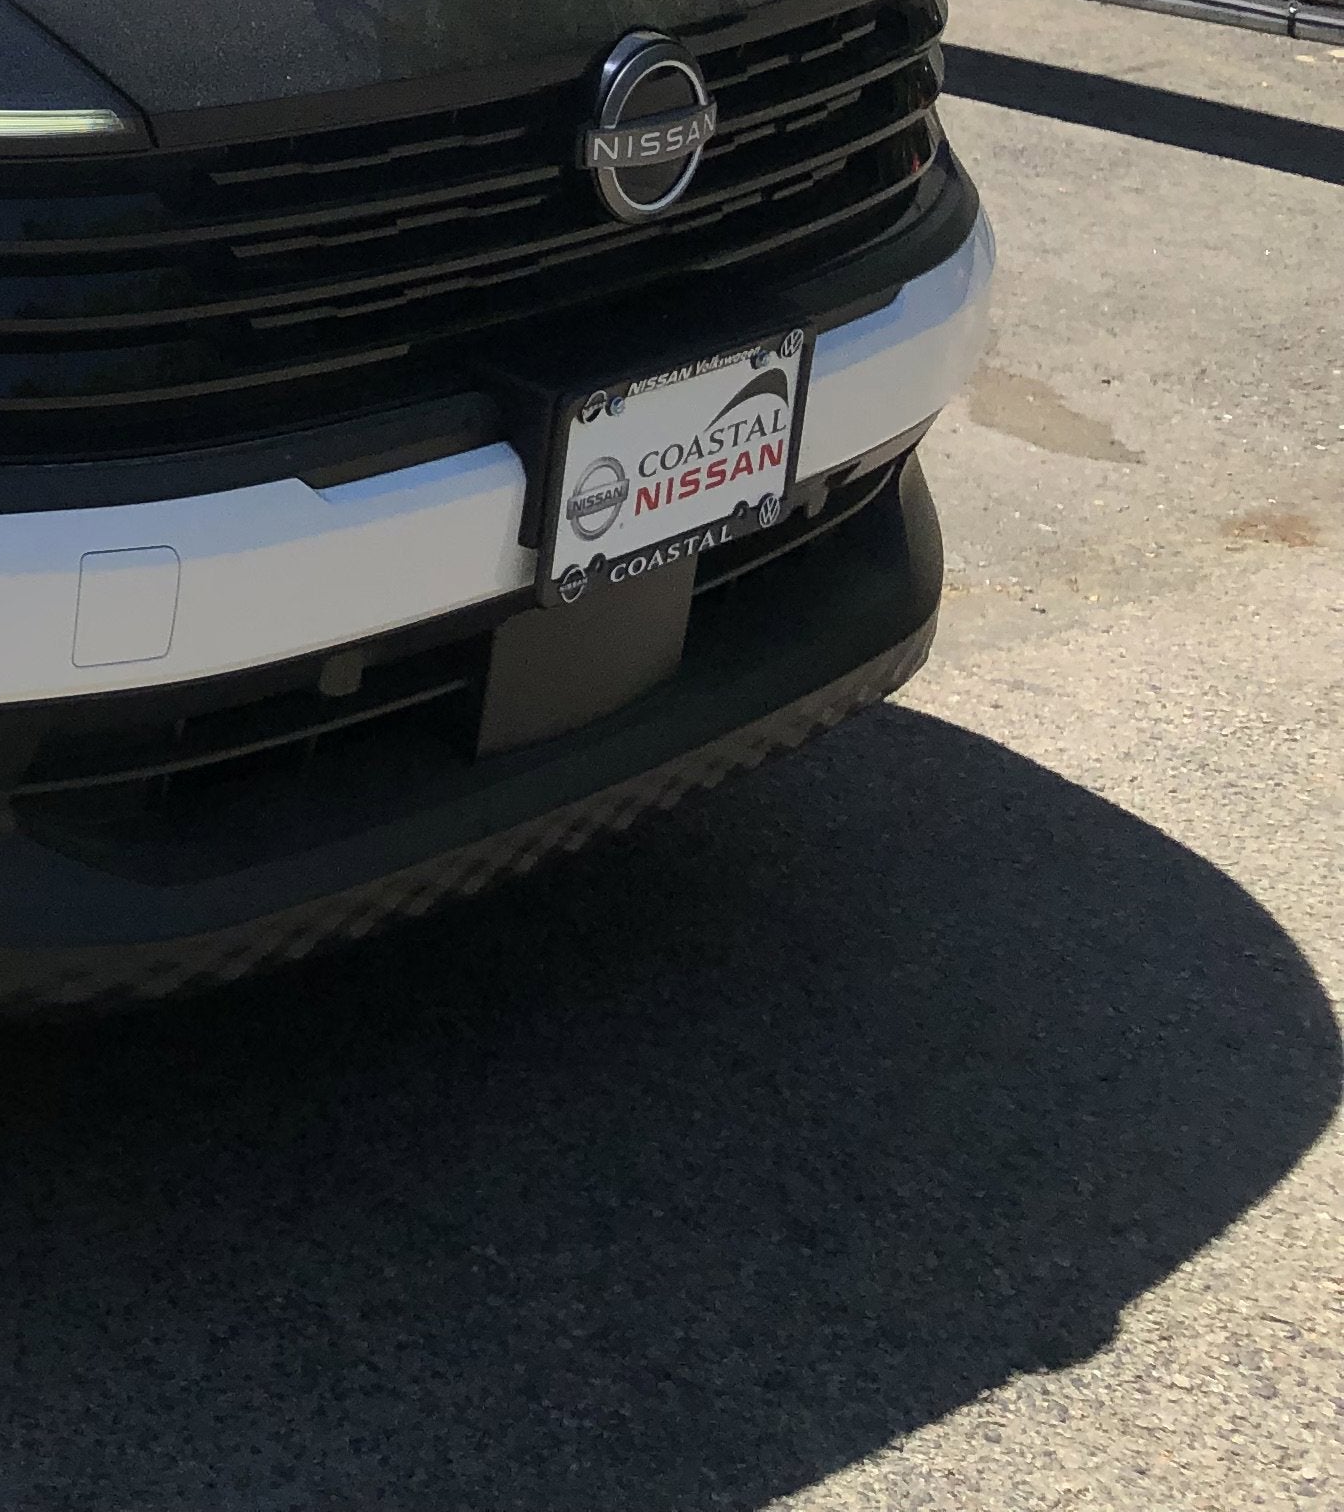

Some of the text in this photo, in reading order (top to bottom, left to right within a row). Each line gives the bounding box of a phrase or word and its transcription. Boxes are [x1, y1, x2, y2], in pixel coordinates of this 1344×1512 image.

[593, 113, 714, 161] NISSAN
[627, 364, 693, 397] NISSAN
[639, 408, 787, 478] COASTAL
[571, 485, 626, 514] NISSAN
[633, 438, 784, 517] NISSAN
[610, 524, 733, 583] COASTAL
